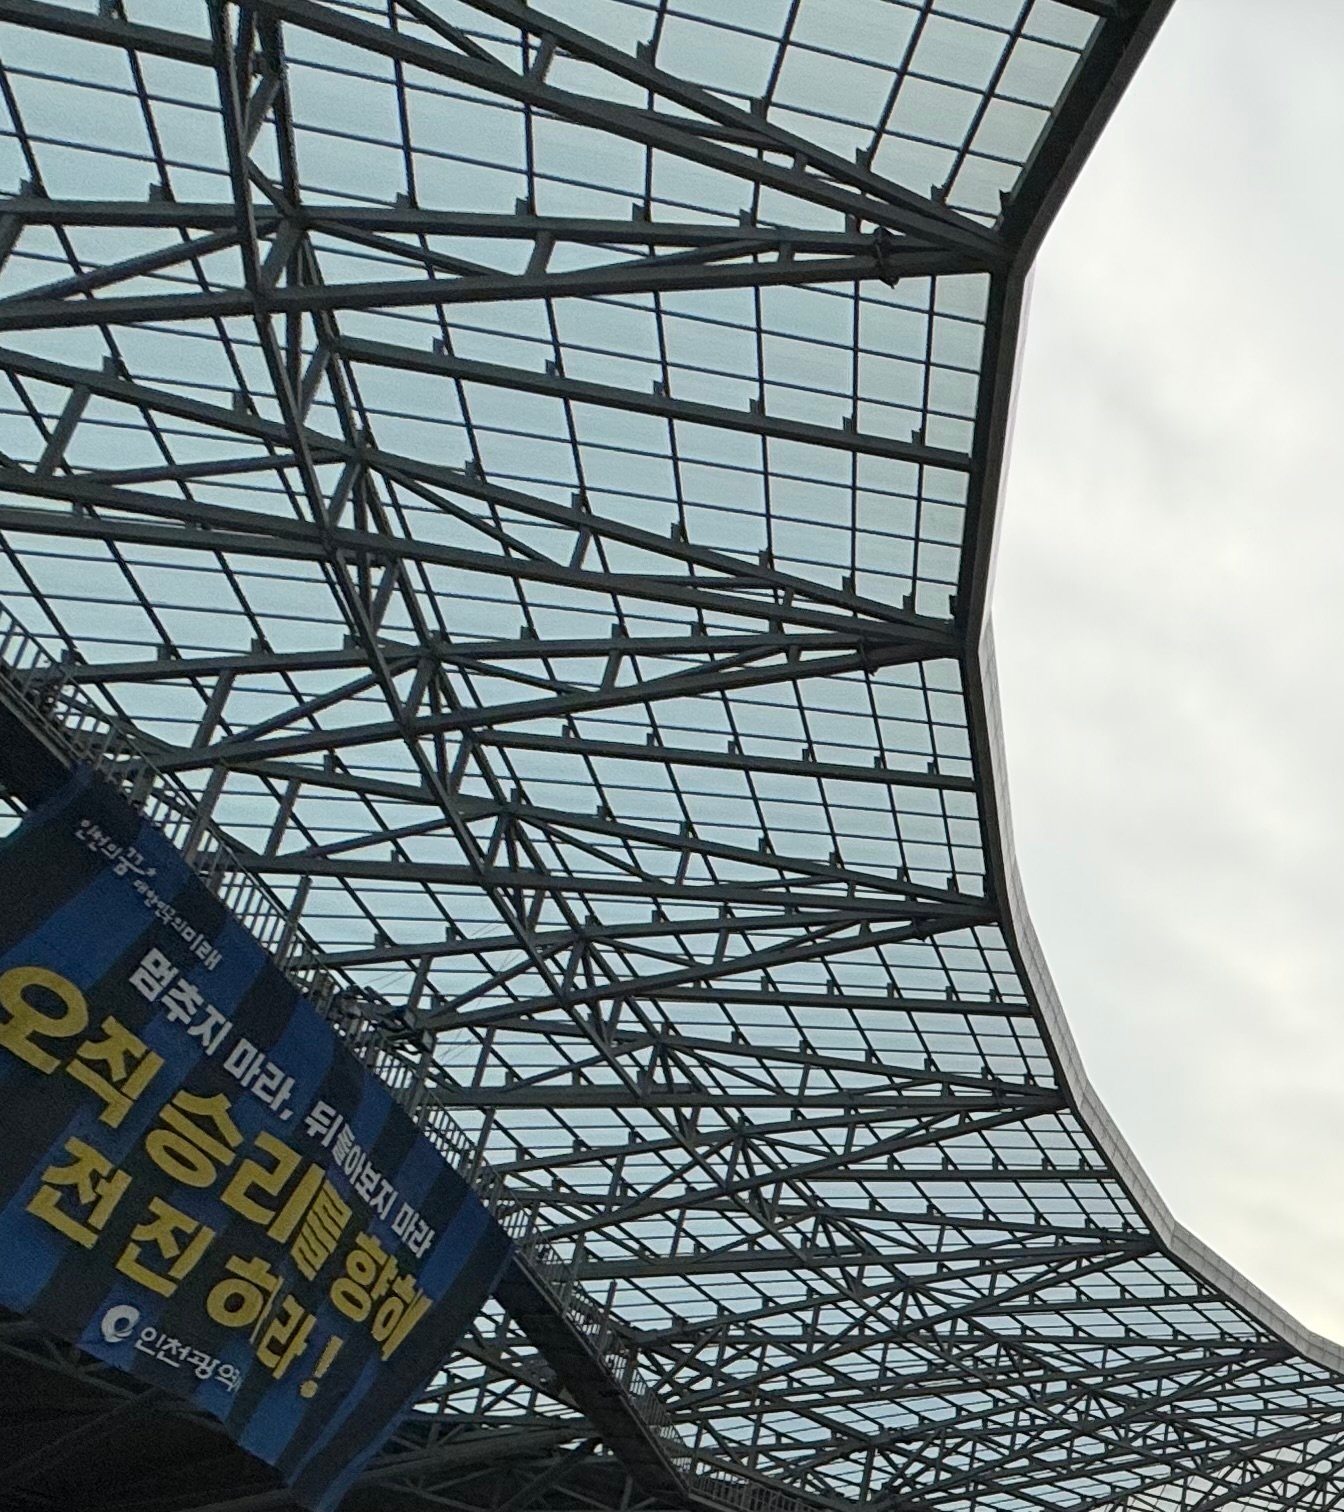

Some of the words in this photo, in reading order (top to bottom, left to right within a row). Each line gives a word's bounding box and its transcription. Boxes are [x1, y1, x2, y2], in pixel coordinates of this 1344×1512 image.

[0, 965, 165, 1129] 오직
[145, 1090, 352, 1281] 승리를
[330, 1231, 433, 1361] 향해
[129, 947, 233, 1056] 멈추지
[223, 1038, 298, 1120] 마라,
[304, 1100, 399, 1220] 뒤돌아보지
[391, 1203, 437, 1259] 마라
[136, 1324, 243, 1394] 인천광역
